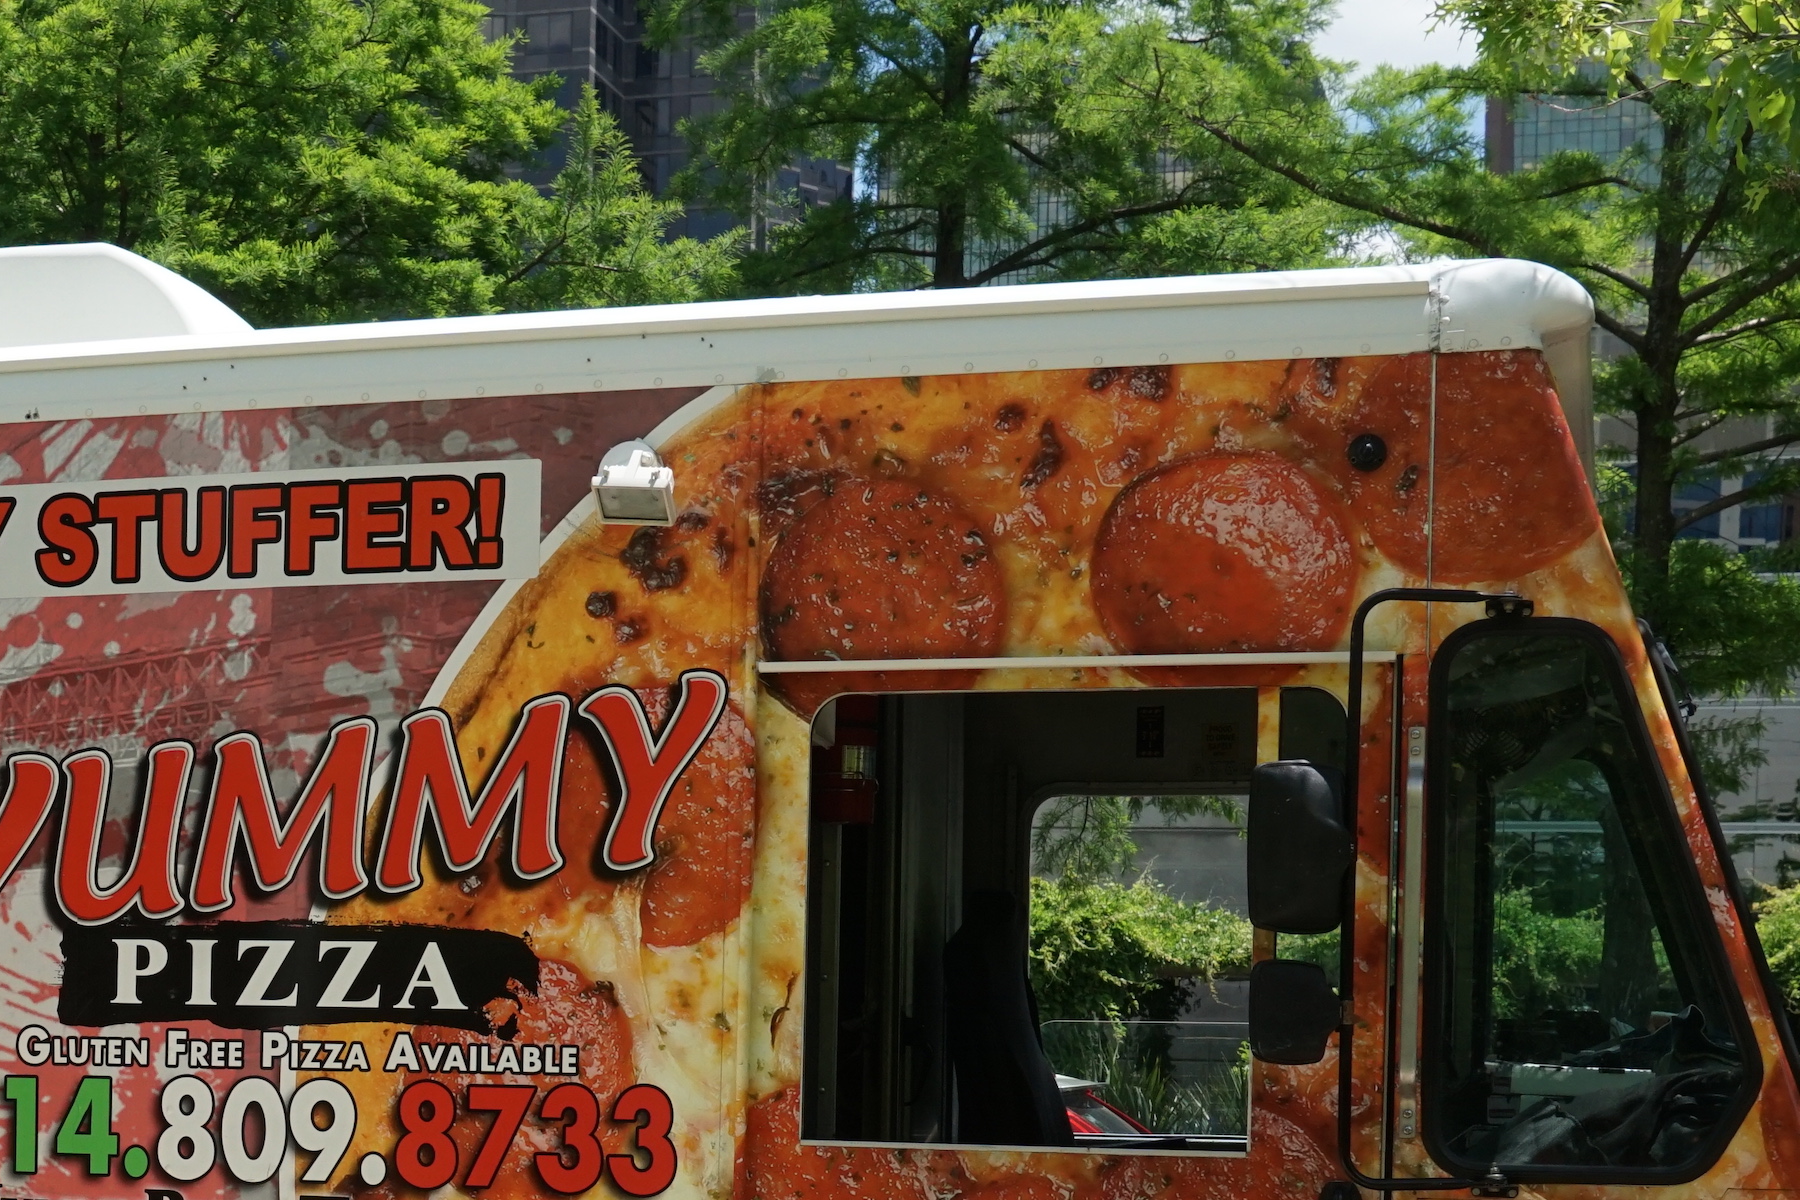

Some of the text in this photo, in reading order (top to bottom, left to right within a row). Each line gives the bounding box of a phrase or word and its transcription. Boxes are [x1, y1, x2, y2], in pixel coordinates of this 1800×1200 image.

[34, 472, 506, 588] STUFFER!
[110, 936, 471, 1011] PIZZA
[17, 1024, 580, 1076] GLUTEN FREE PIZZA AVAILABLE
